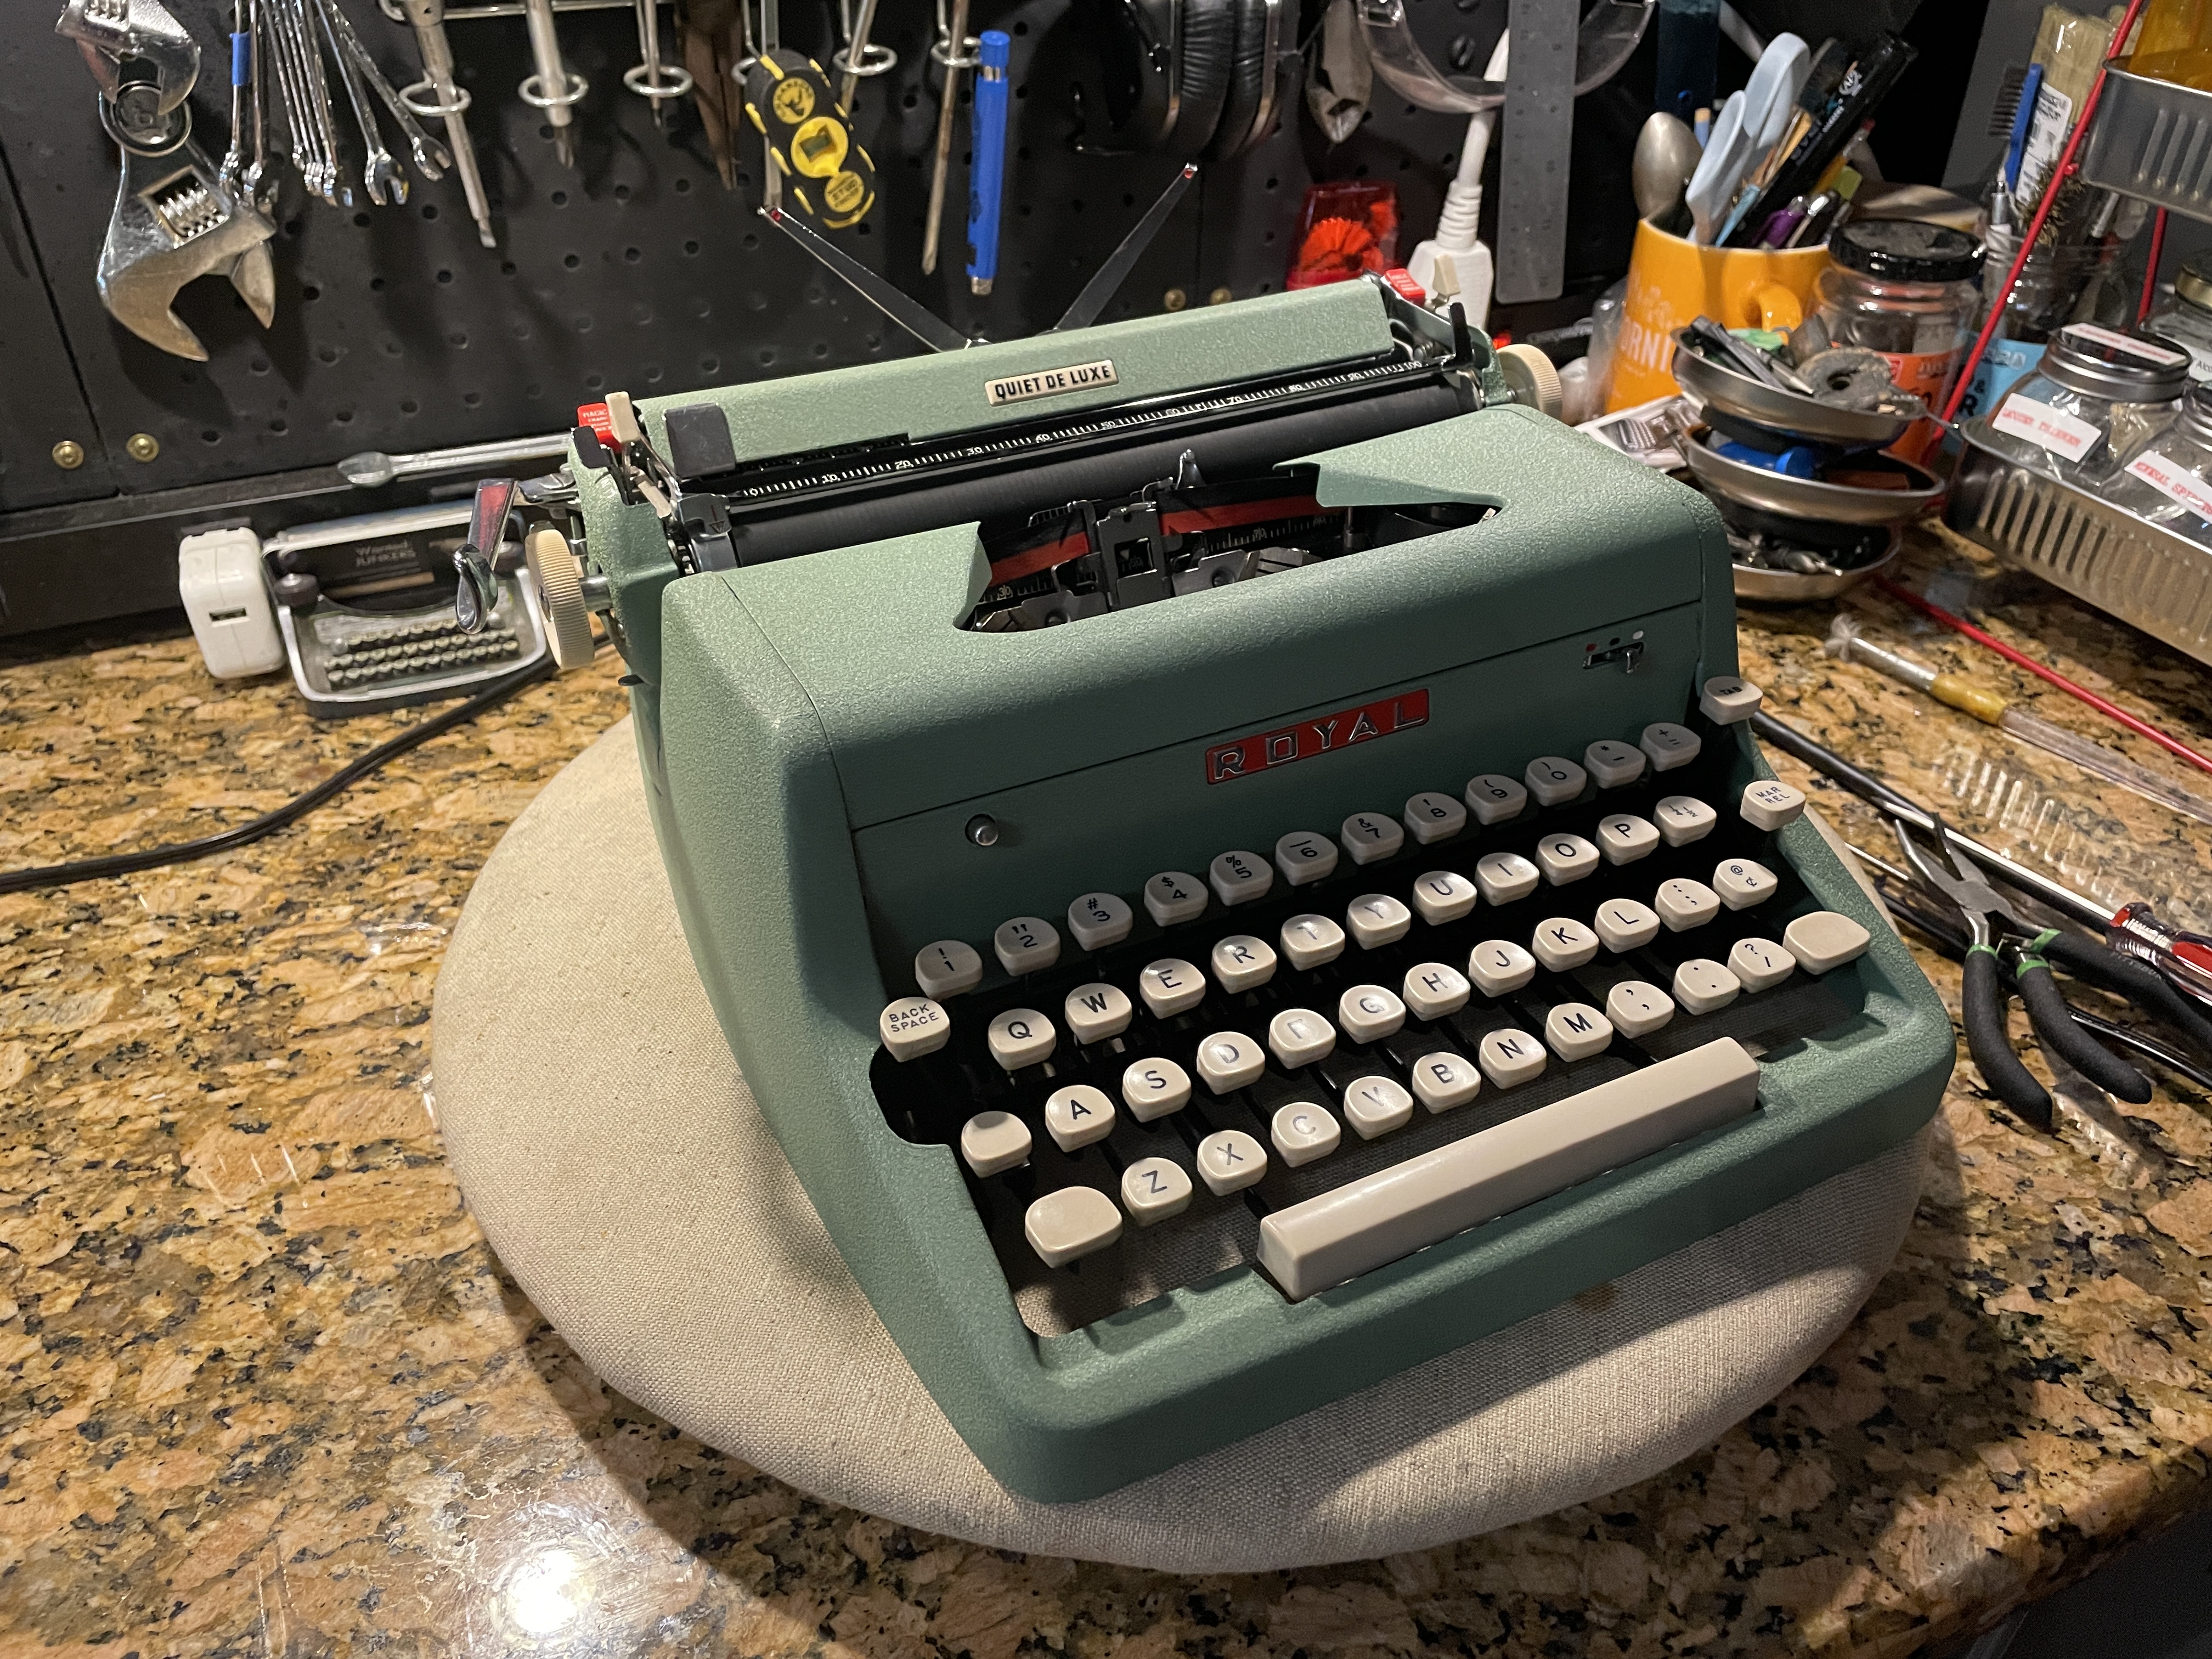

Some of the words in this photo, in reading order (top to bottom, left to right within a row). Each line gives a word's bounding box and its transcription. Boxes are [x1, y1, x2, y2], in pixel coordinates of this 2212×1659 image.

[995, 377, 1041, 399] QUIET
[1045, 373, 1065, 389] DE
[1070, 365, 1110, 383] LUXE
[967, 447, 983, 456] 30
[1719, 686, 1742, 696] TAB
[1214, 702, 1424, 780] ROYAL
[1491, 788, 1508, 799] 9
[1756, 786, 1781, 798] MAR
[1764, 794, 1791, 804] REL
[1430, 808, 1447, 818] 8
[1365, 827, 1380, 838] 7
[1614, 823, 1630, 838] P
[1300, 847, 1318, 857] 6
[1555, 843, 1576, 857] O
[1226, 855, 1242, 867] %
[1235, 867, 1252, 878] 5
[1497, 863, 1513, 877] I
[1730, 865, 1743, 876] @
[1161, 876, 1174, 888] $
[1430, 879, 1454, 896] U
[1172, 889, 1187, 899] 4
[1087, 898, 1098, 910] #
[1093, 910, 1110, 922] 3
[1613, 911, 1639, 924] L
[1020, 935, 1037, 947] 2
[1551, 927, 1578, 945] K
[1232, 945, 1256, 964] R
[1745, 944, 1758, 955] ?
[1496, 950, 1511, 967] J
[1158, 969, 1183, 989] E
[1421, 973, 1448, 992] H
[1081, 992, 1108, 1013] W
[1359, 997, 1385, 1014] G
[889, 1003, 930, 1023] BACK
[891, 1012, 939, 1032] SPACE
[1008, 1021, 1032, 1039] Q
[1563, 1013, 1593, 1033] M
[1216, 1044, 1240, 1064] D
[1497, 1039, 1524, 1059] N
[1144, 1070, 1167, 1089] S
[1431, 1063, 1455, 1084] B
[1362, 1086, 1384, 1107] V
[1070, 1099, 1092, 1120] A
[1293, 1115, 1316, 1135] C
[1216, 1143, 1244, 1165] X
[1141, 1170, 1168, 1194] Z
